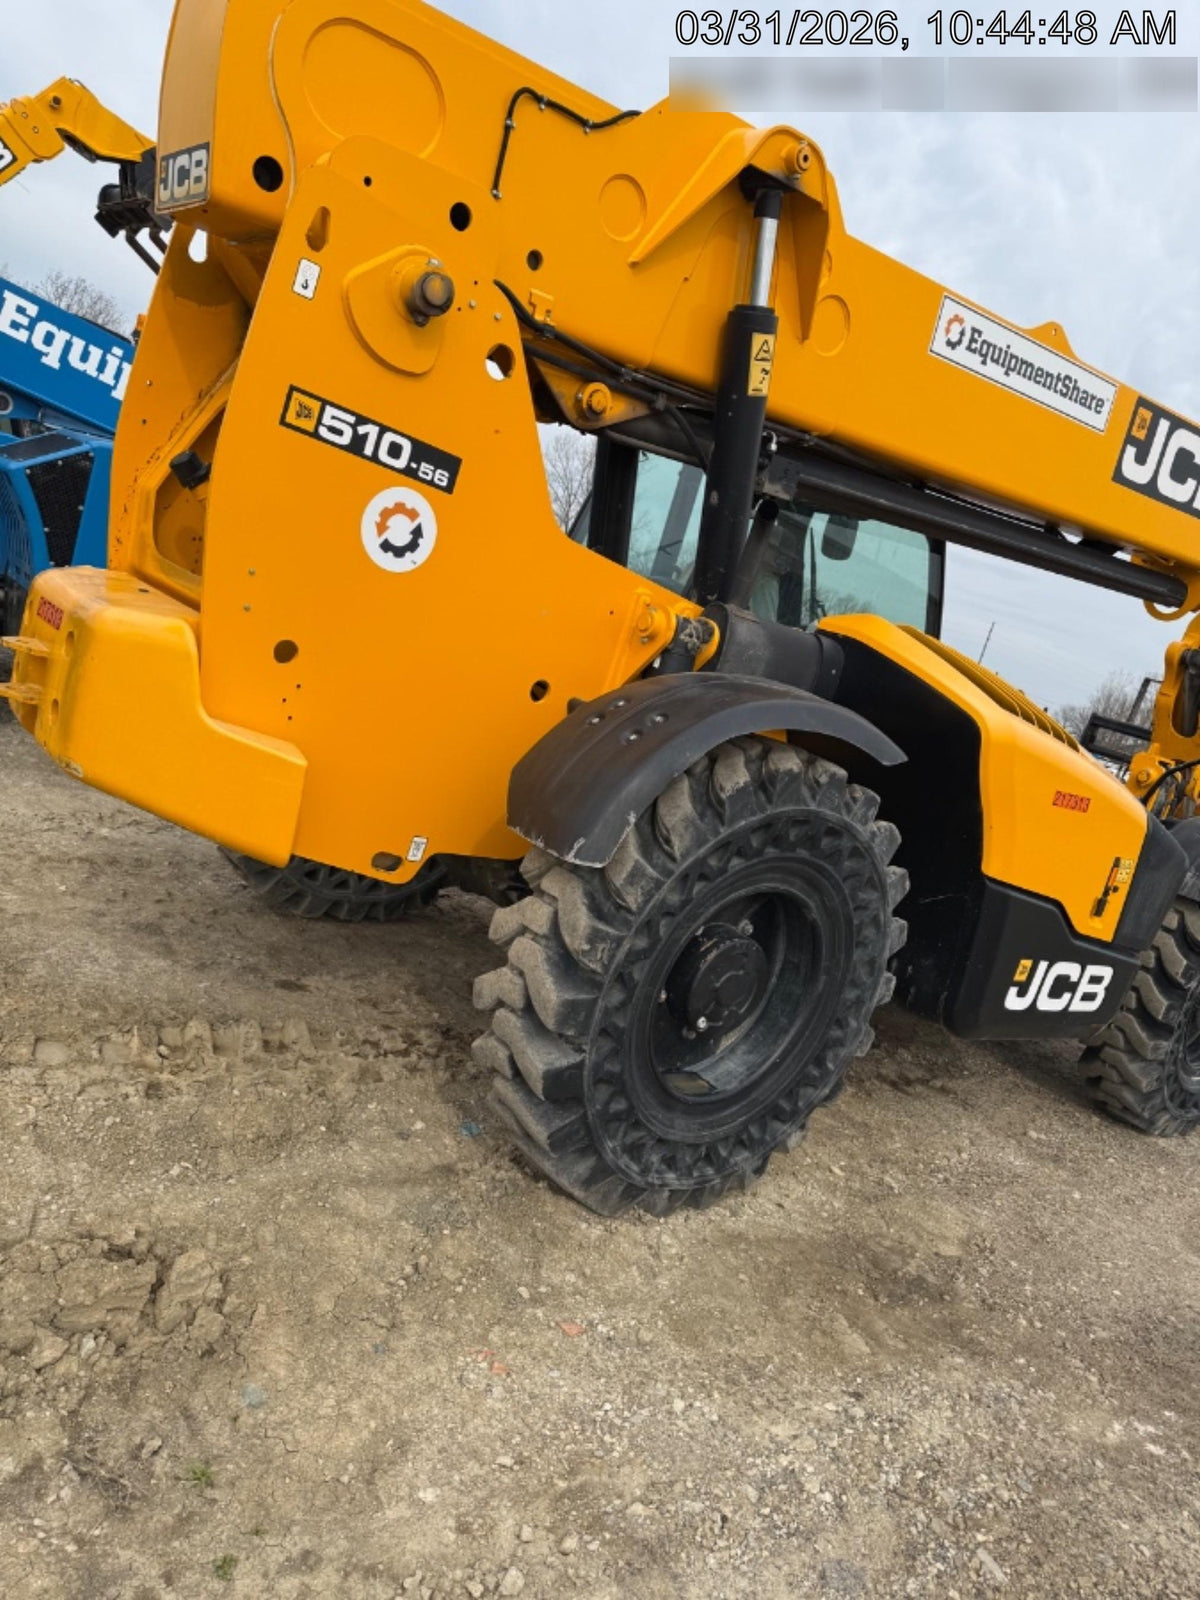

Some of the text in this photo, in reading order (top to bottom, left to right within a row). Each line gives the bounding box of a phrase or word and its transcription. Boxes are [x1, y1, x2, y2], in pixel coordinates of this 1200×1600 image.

[159, 148, 207, 201] JCB
[965, 326, 1106, 415] EquipmentShare
[1121, 417, 1200, 510] JC
[1004, 960, 1114, 1012] JCB
